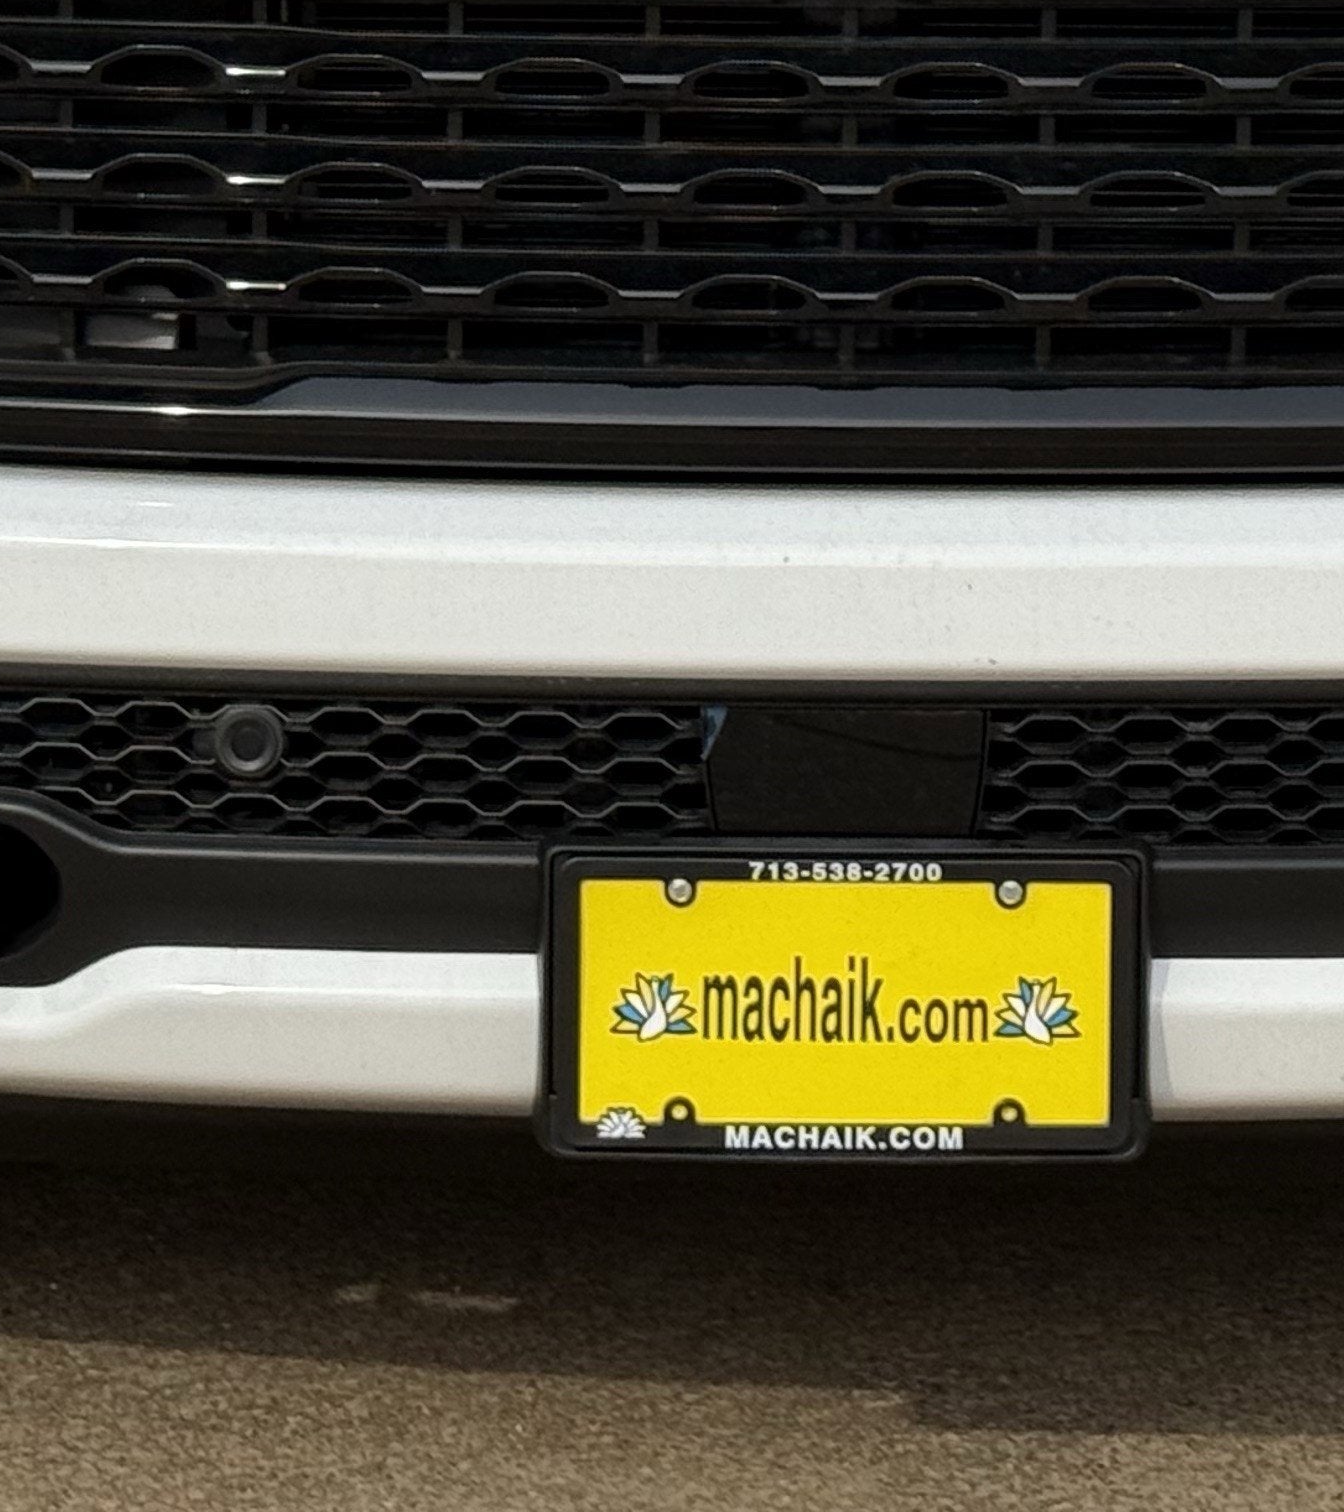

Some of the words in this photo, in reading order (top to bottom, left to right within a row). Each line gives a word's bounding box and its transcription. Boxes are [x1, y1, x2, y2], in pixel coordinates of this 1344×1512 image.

[748, 861, 943, 882] 713-538-2700
[701, 956, 989, 1044] machaik.com
[723, 1125, 964, 1151] MACHAIK.COM
